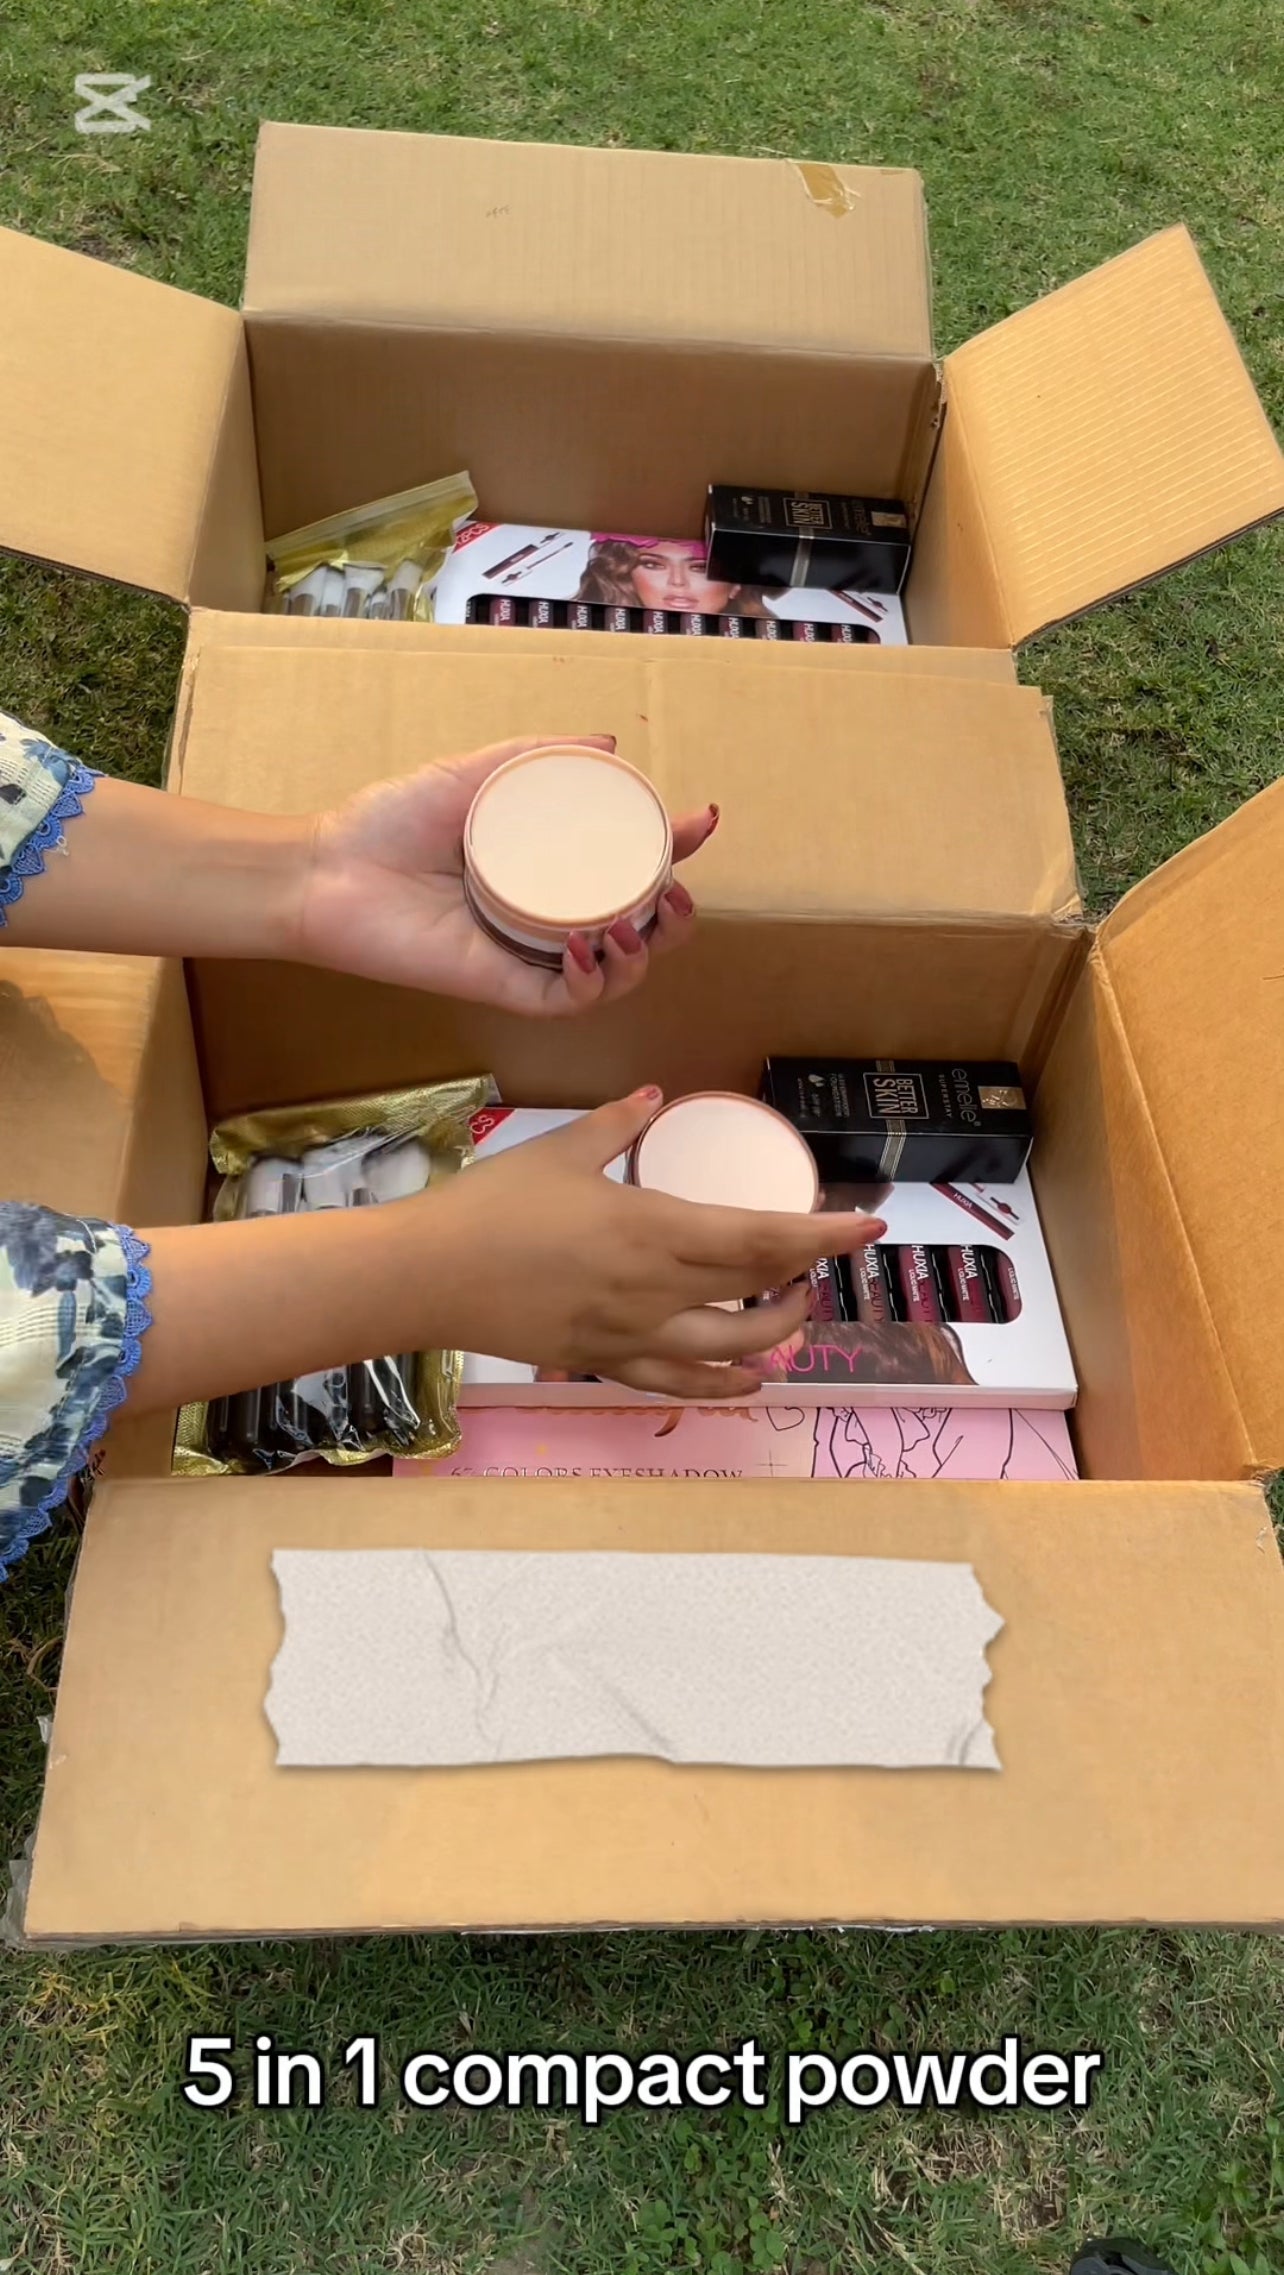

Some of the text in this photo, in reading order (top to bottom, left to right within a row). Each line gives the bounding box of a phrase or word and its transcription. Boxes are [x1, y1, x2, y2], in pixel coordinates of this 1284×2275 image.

[873, 1078, 901, 1114] SKIN
[896, 1079, 919, 1114] BETTER
[816, 1257, 830, 1280] XIA
[863, 1244, 880, 1279] HUXIA
[911, 1245, 929, 1280] HUXIA
[960, 1245, 978, 1279] HUXIA
